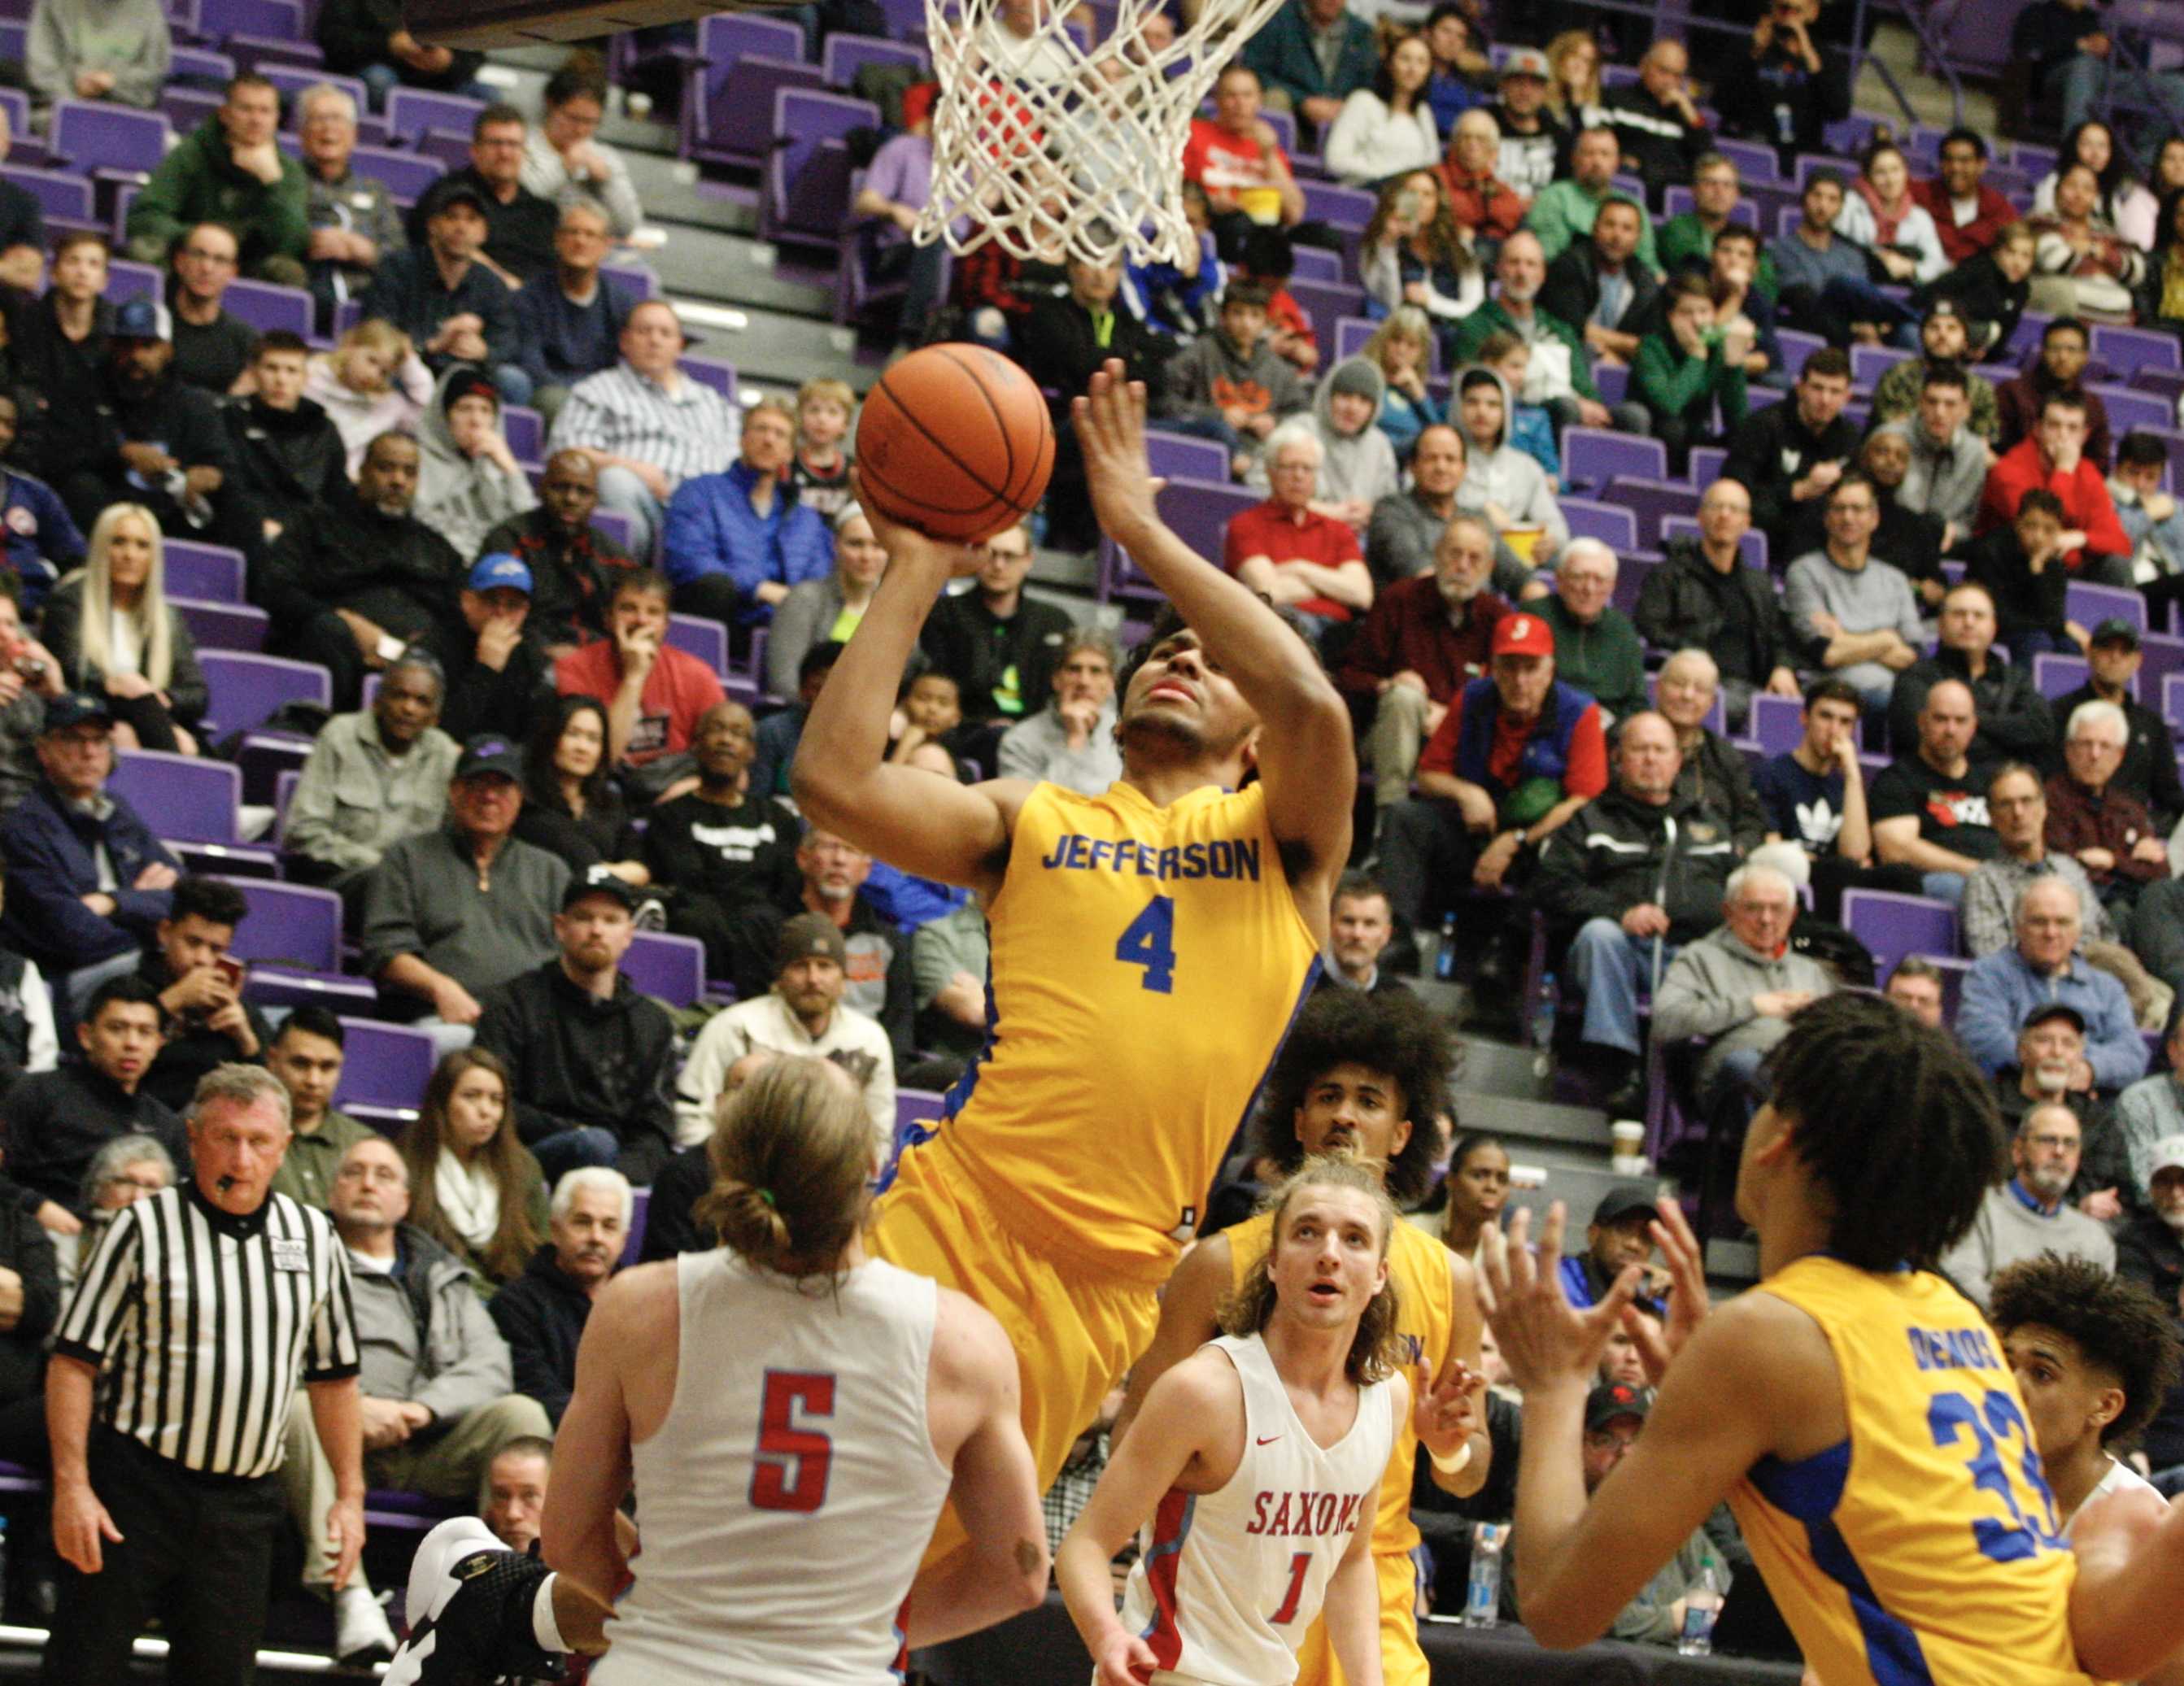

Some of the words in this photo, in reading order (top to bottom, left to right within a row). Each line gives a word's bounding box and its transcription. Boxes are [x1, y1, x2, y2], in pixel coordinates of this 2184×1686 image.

[1042, 834, 1260, 882] JEFFERSON
[1115, 894, 1176, 994] 4
[748, 1369, 836, 1515] 5
[1926, 1389, 2070, 1564] 33
[1269, 1552, 1314, 1625] 1
